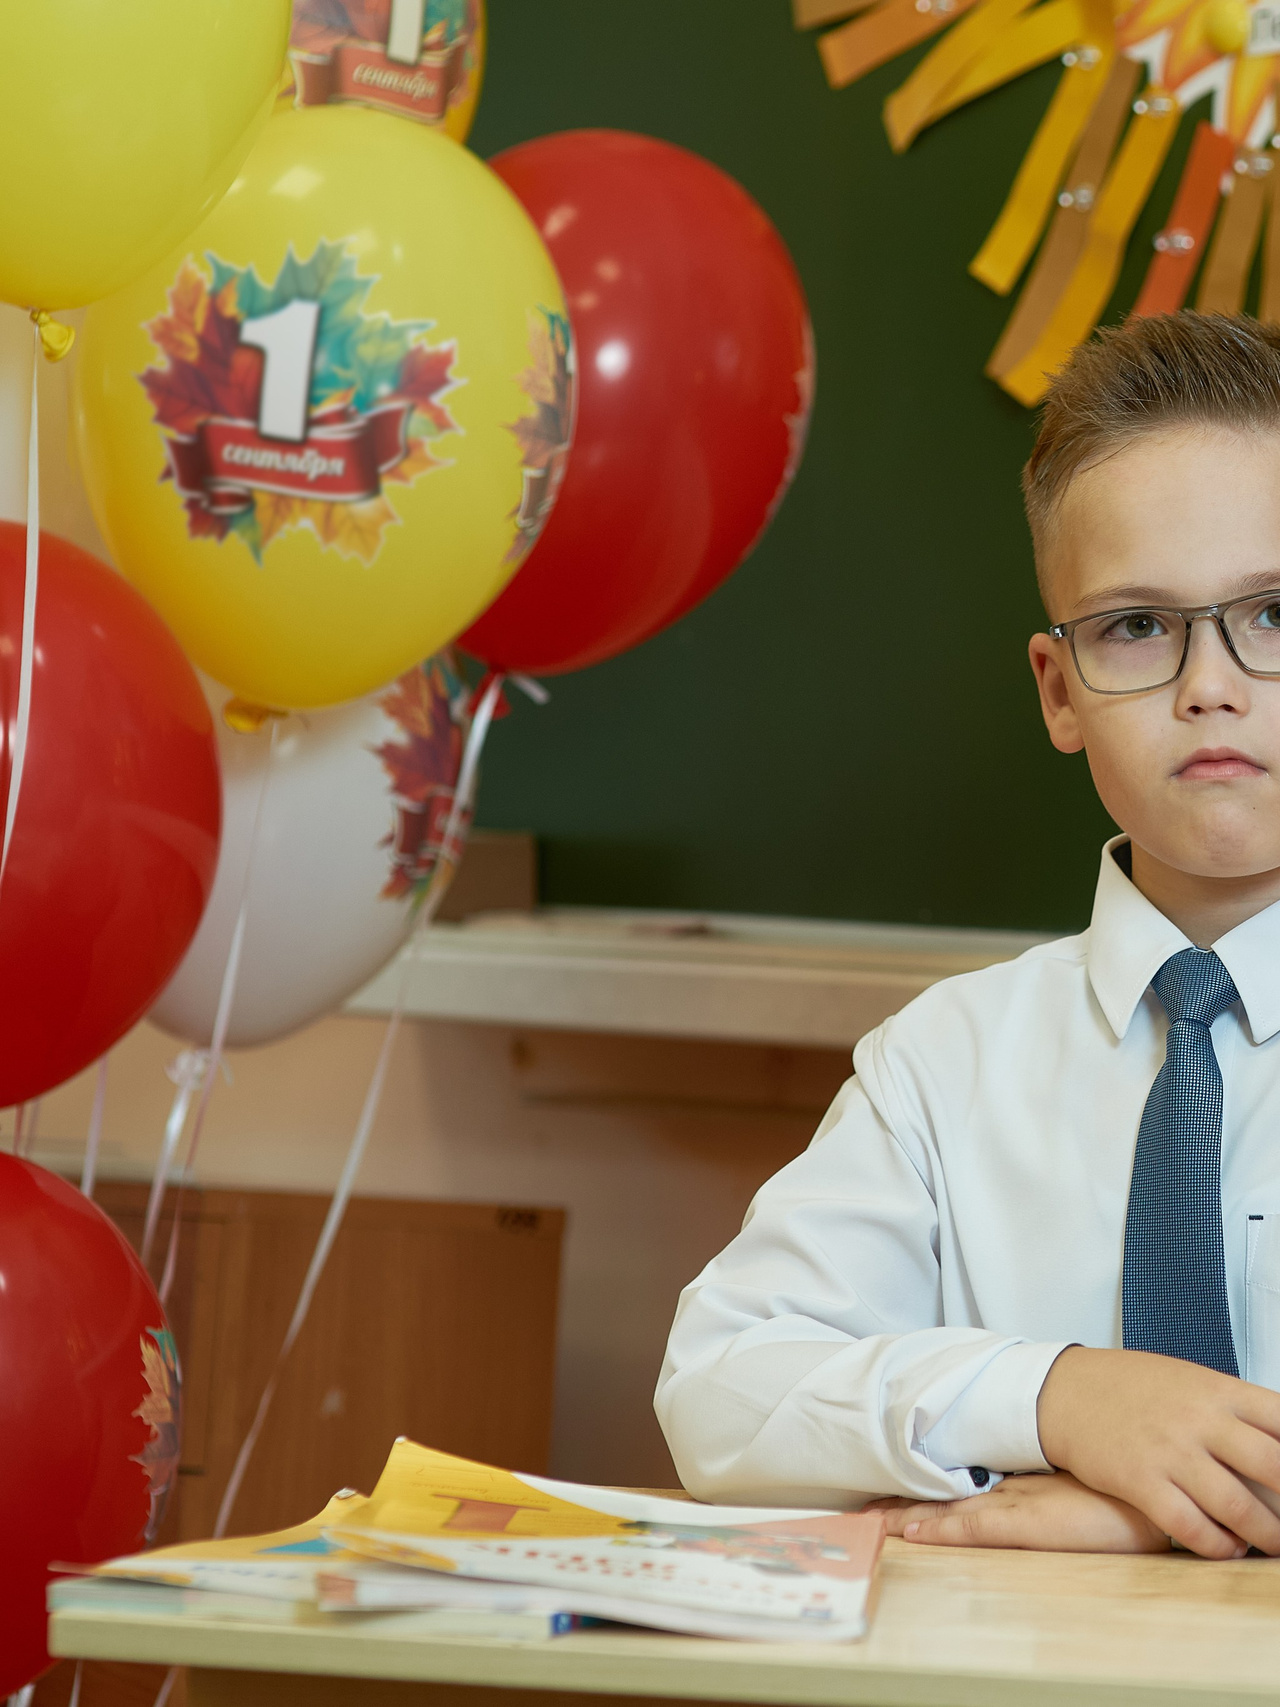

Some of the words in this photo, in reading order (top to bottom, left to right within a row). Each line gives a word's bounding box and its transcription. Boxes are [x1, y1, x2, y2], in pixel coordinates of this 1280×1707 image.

[352, 62, 440, 101] сентября
[239, 296, 321, 444] 1
[221, 443, 345, 482] сентября
